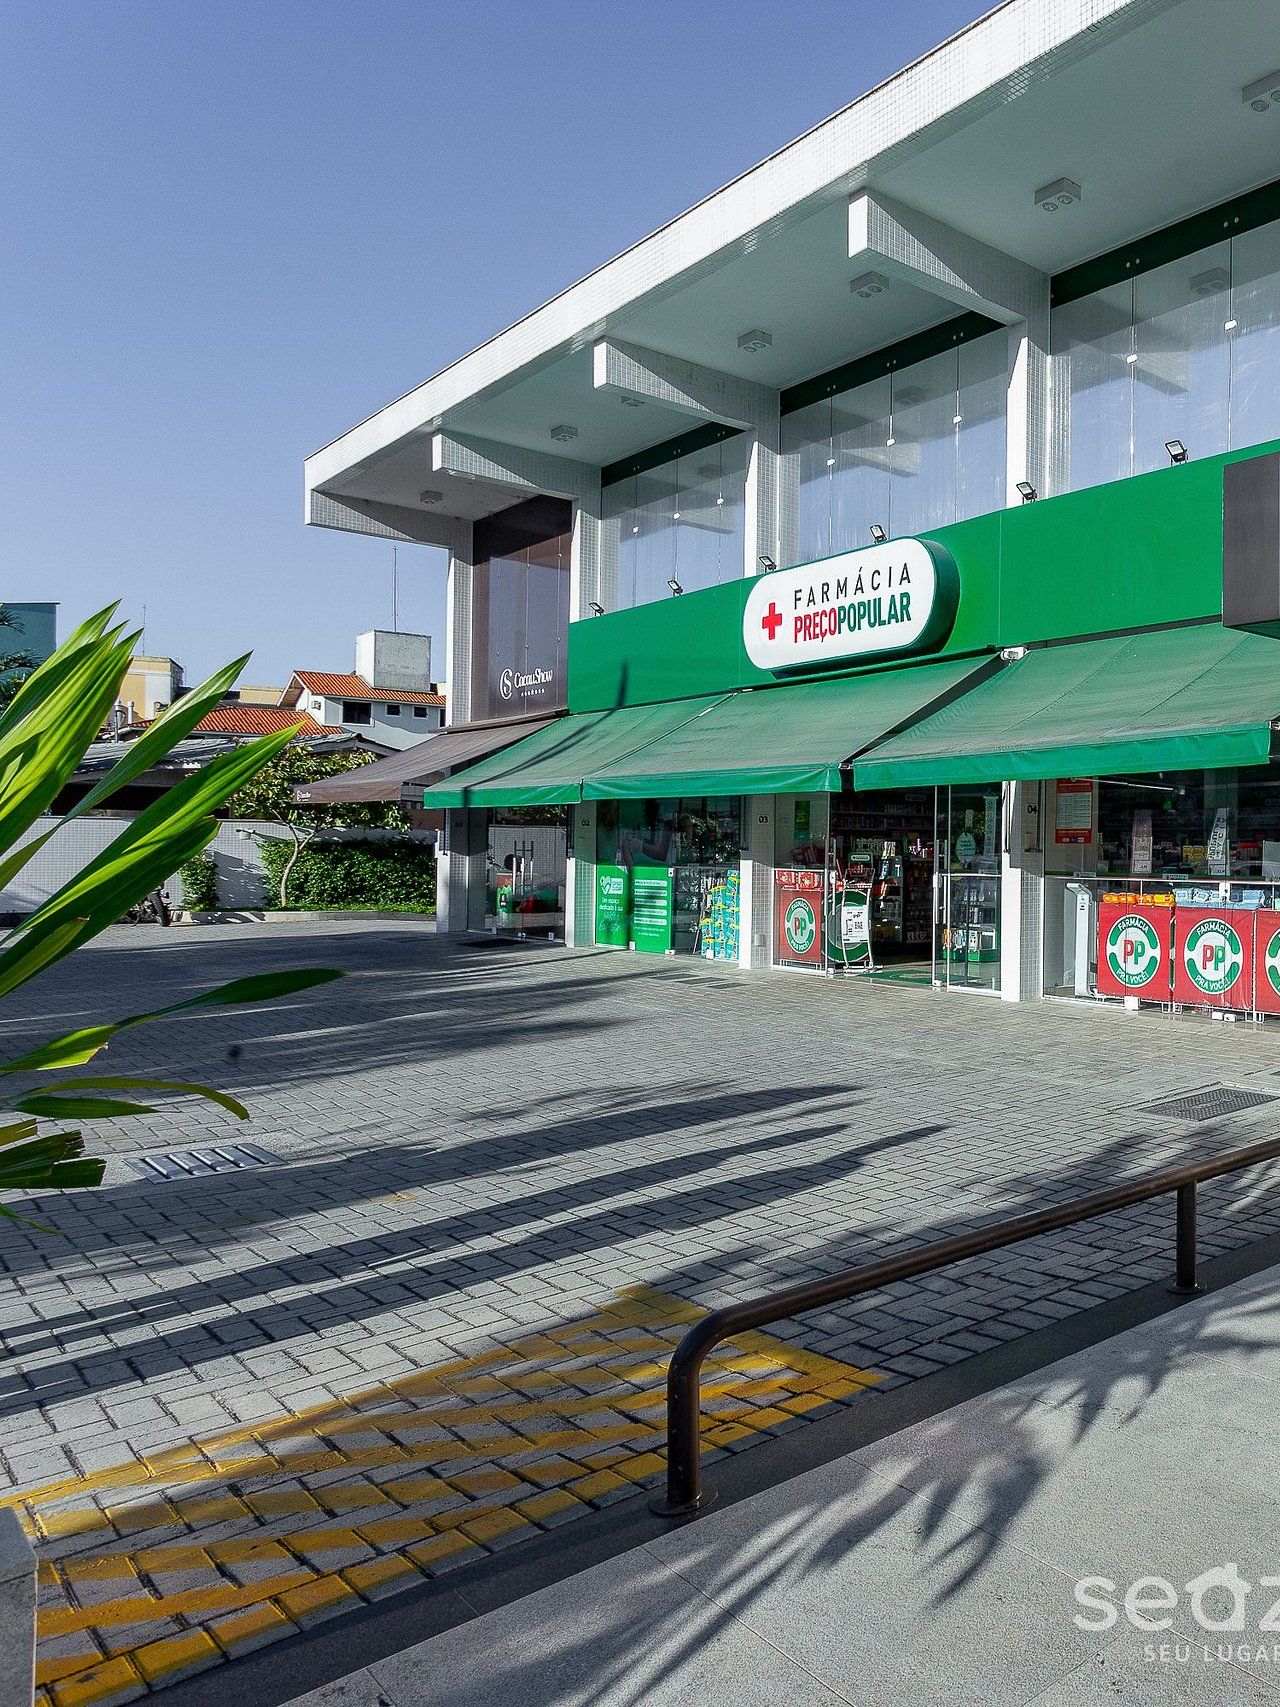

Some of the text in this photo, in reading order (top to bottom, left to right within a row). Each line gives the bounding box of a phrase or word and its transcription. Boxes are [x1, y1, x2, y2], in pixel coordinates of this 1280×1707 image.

[794, 563, 911, 610] FARMÁCIA
[794, 592, 911, 643] PREÇOPOPULAR
[1027, 804, 1038, 814] 04
[581, 819, 590, 827] 02
[758, 815, 769, 823] 03
[794, 917, 806, 936] PP
[1118, 917, 1149, 934] FARMÁCIA
[1197, 920, 1231, 938] FARMÁCIA
[1123, 940, 1146, 965] PP
[1202, 944, 1225, 971] PP
[1116, 968, 1128, 982] PRA
[1195, 975, 1209, 990] PRA
